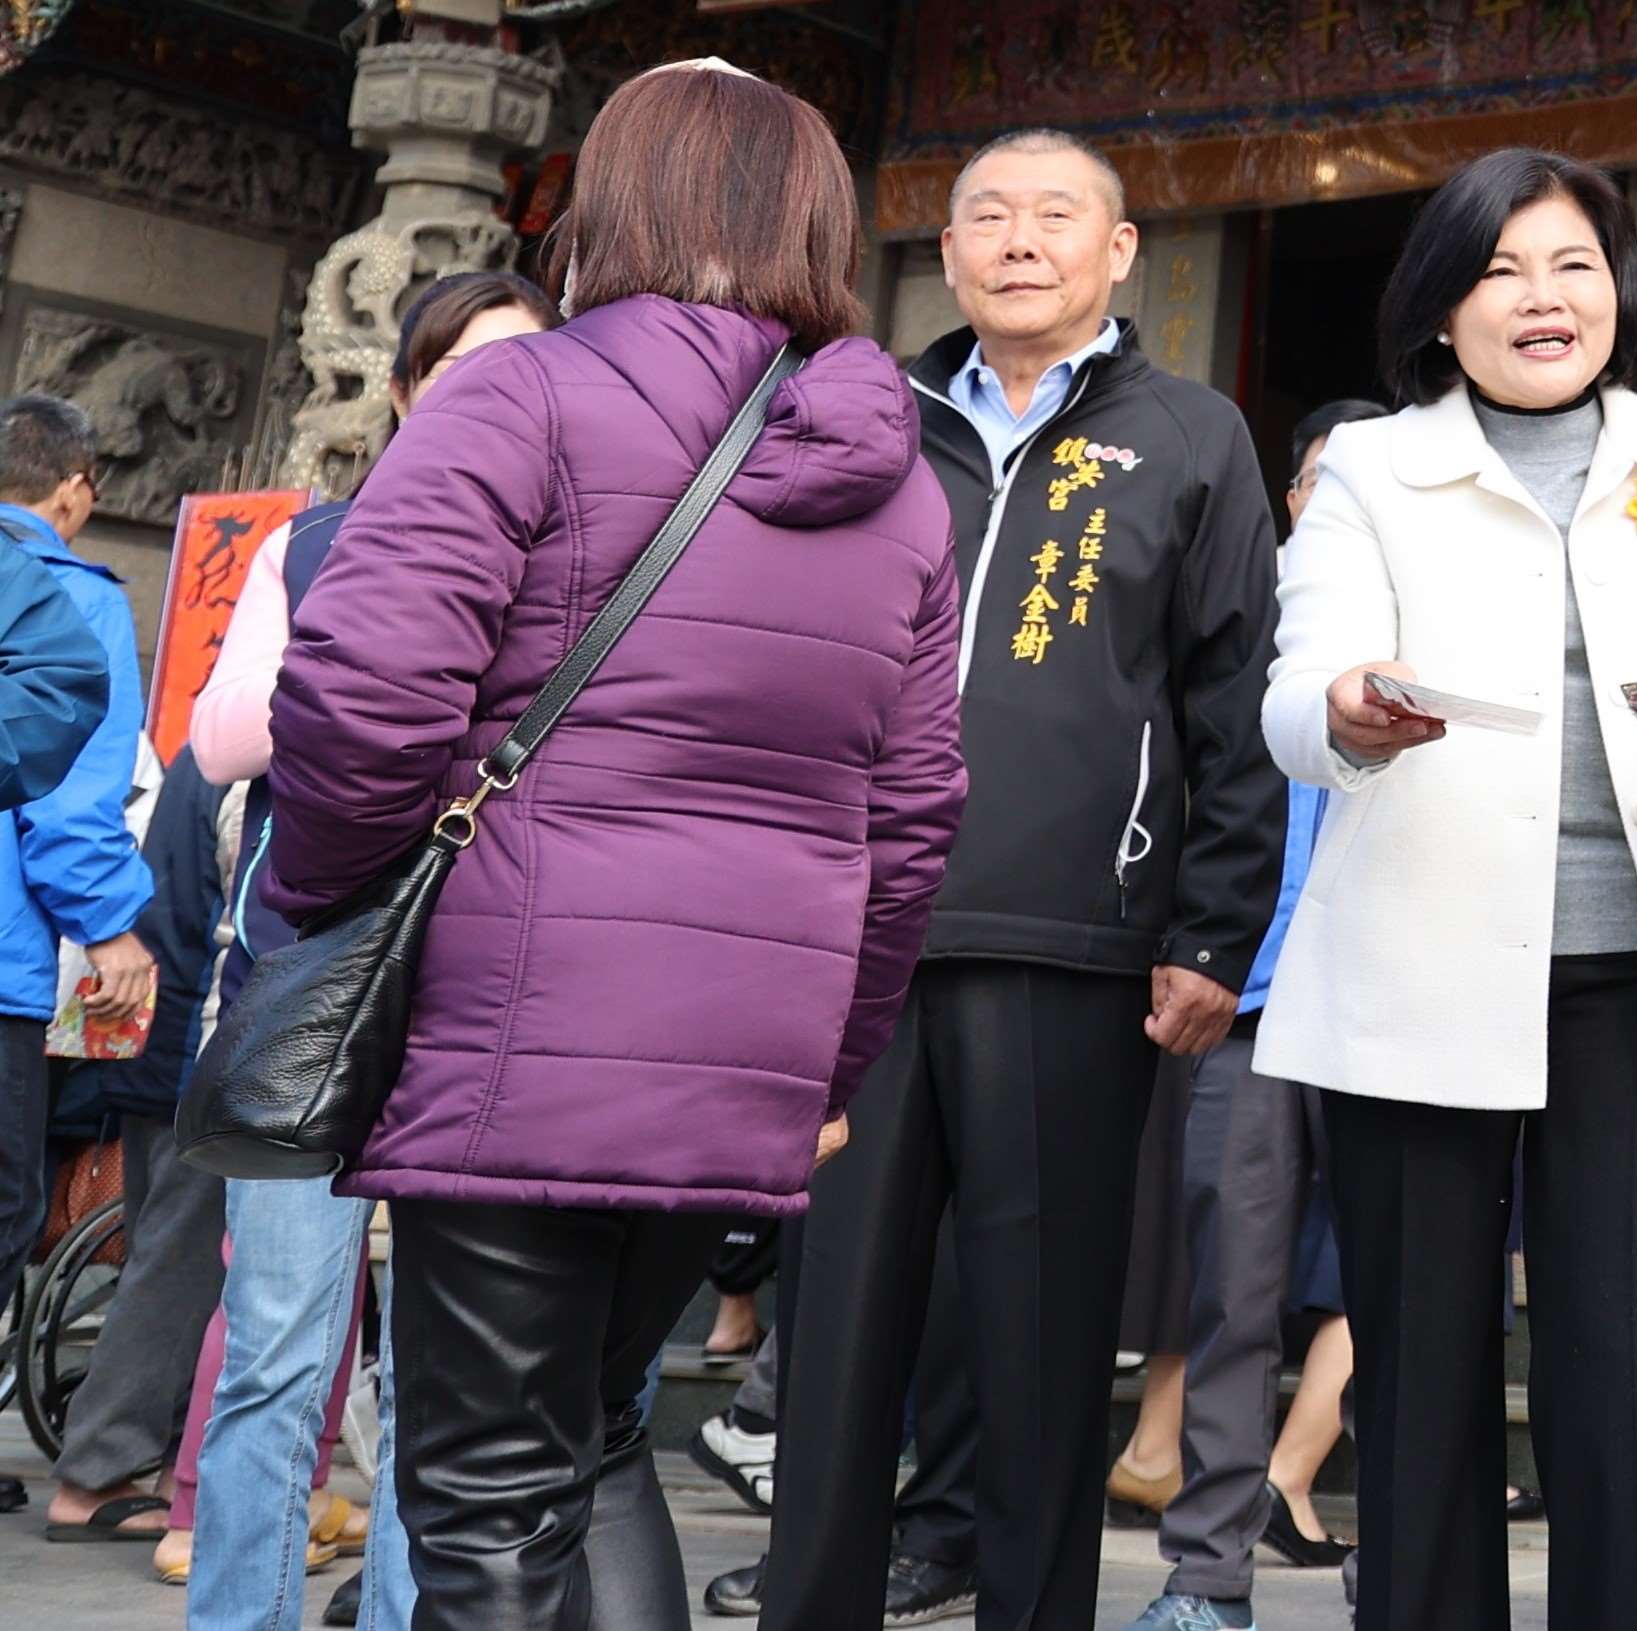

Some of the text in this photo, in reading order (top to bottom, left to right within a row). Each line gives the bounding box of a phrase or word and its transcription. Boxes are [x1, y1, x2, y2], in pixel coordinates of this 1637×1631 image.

[1048, 437, 1106, 512] 鎮安宮
[1011, 539, 1065, 665] 章金樹
[1068, 508, 1108, 627] 主任委員
